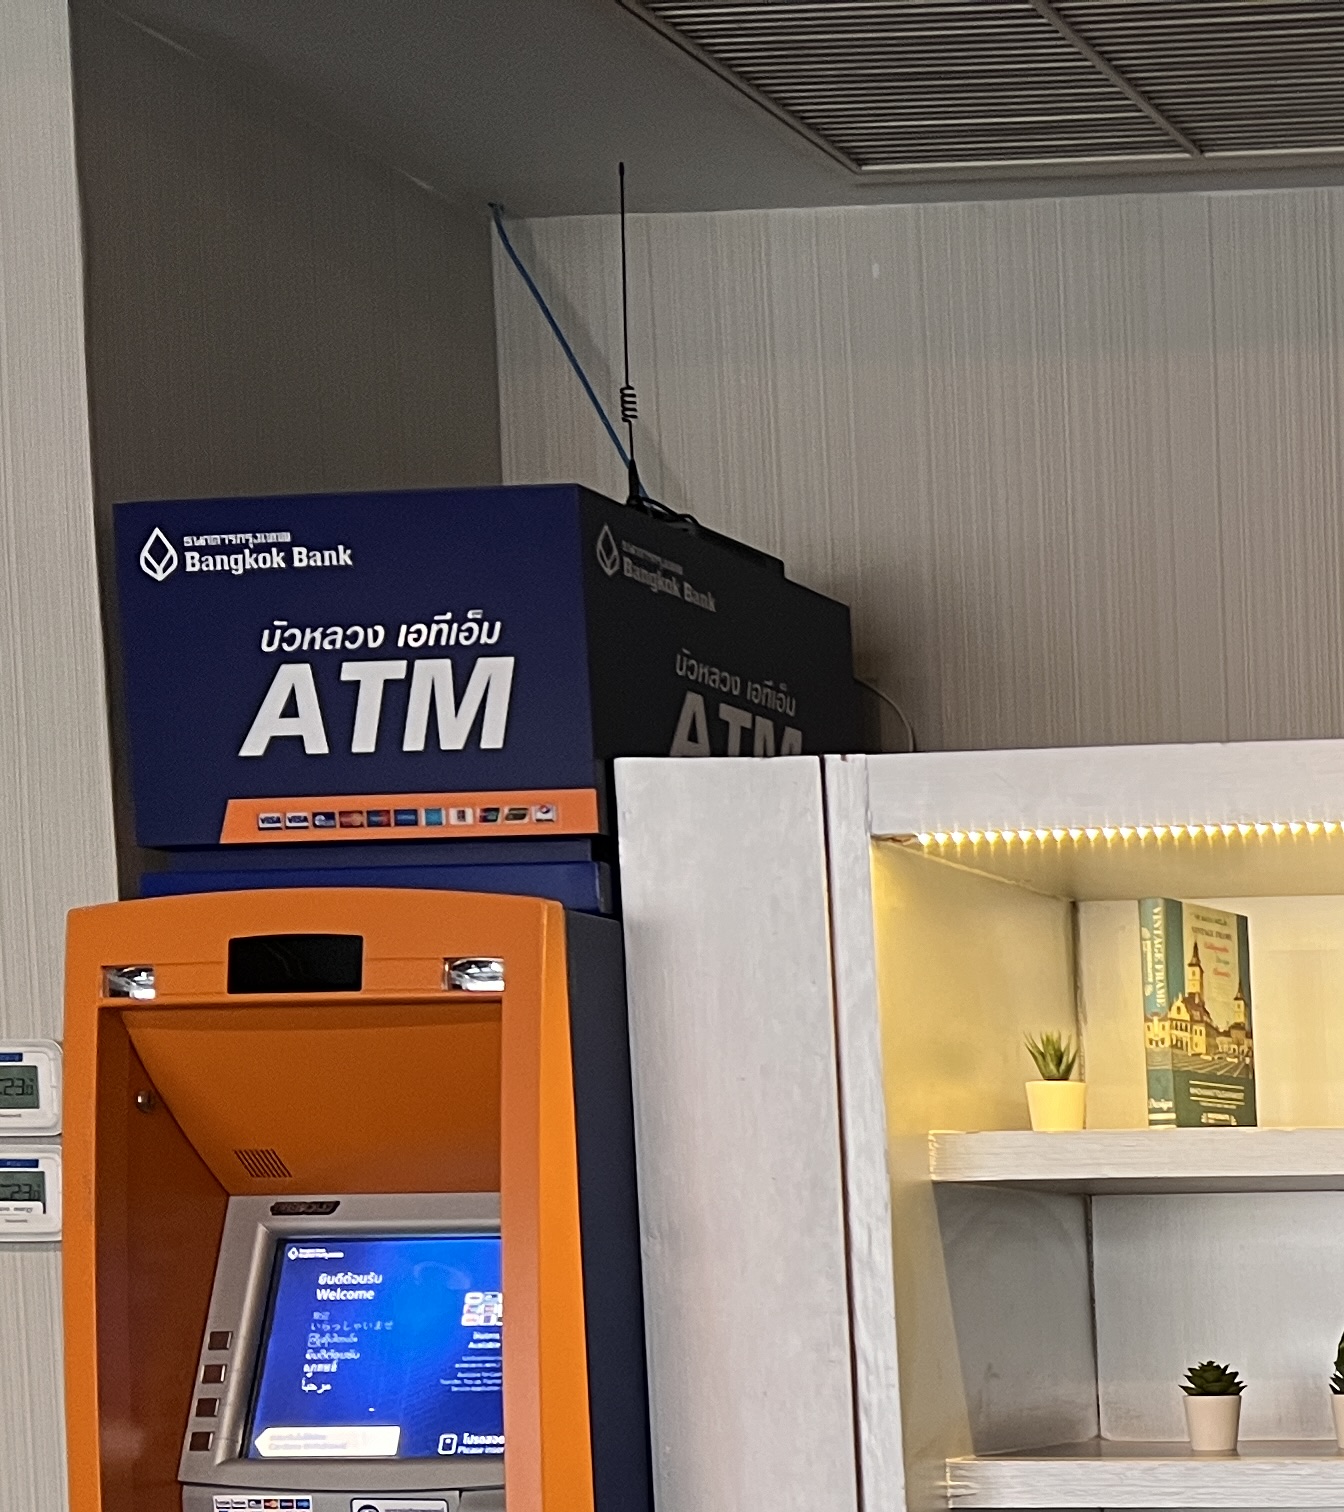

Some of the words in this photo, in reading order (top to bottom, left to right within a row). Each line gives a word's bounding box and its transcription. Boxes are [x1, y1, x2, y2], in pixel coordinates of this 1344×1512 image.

[183, 546, 286, 575] Bangkok
[292, 544, 354, 568] Bank
[622, 555, 684, 599] Bangkok
[683, 580, 717, 613] Bank
[260, 619, 386, 653] บัวหลวง
[396, 609, 503, 649] เอทีเอ็ม
[237, 655, 516, 758] ATM
[669, 689, 804, 758] ATM
[1152, 906, 1165, 964] VINTAGE
[316, 1287, 375, 1301] Welcome
